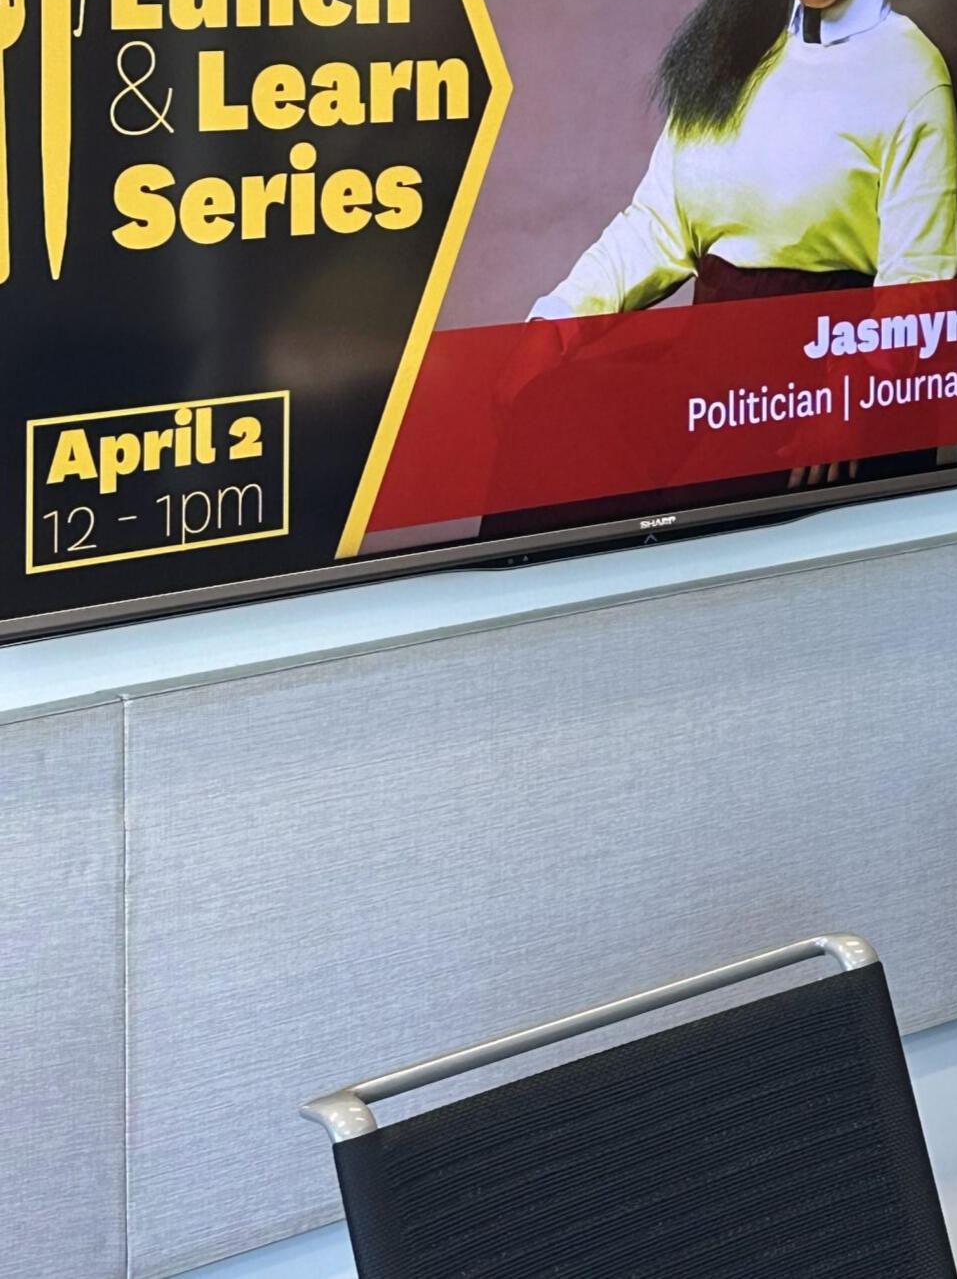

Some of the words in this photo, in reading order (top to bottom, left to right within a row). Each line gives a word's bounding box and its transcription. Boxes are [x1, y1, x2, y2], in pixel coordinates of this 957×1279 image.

[110, 41, 174, 135] &
[198, 50, 470, 132] Learn
[112, 142, 423, 250] Series
[688, 382, 832, 432] Politician
[46, 407, 216, 494] April
[228, 416, 263, 460] 2
[43, 506, 97, 554] 12
[156, 483, 263, 545] 1pm
[640, 516, 676, 530] SHARP
